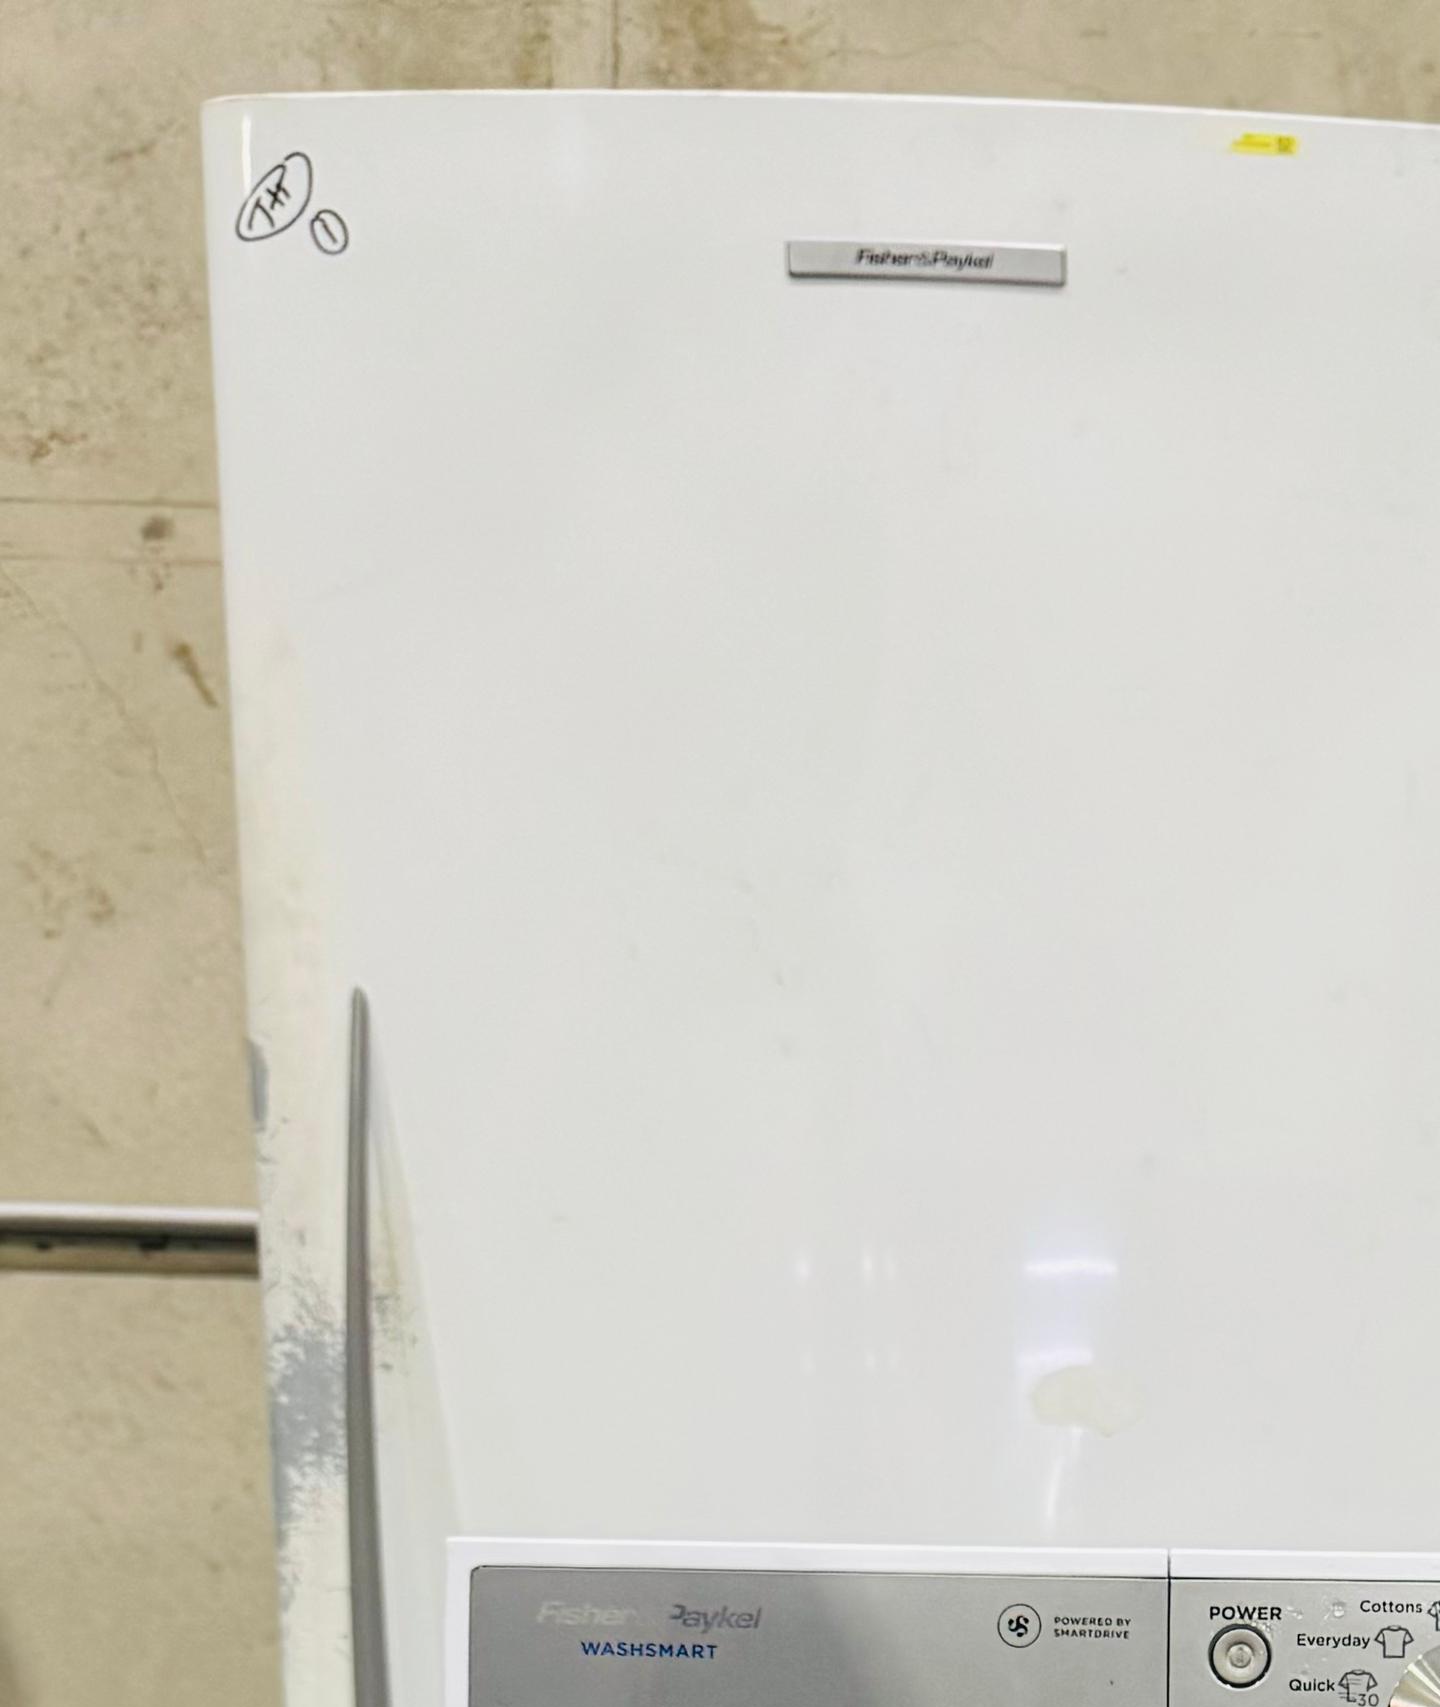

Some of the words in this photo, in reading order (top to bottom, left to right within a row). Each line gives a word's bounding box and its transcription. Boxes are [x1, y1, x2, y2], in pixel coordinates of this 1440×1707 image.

[1210, 1606, 1281, 1620] POWER
[1360, 1600, 1422, 1613] Cottons
[1054, 1617, 1112, 1626] POWERED
[1117, 1618, 1131, 1626] BY
[1054, 1629, 1128, 1639] SMARTDRIVE
[1297, 1634, 1370, 1649] Everyday
[581, 1642, 717, 1659] WASHSMART
[1289, 1679, 1335, 1691] Quick
[1357, 1693, 1379, 1707] 30
